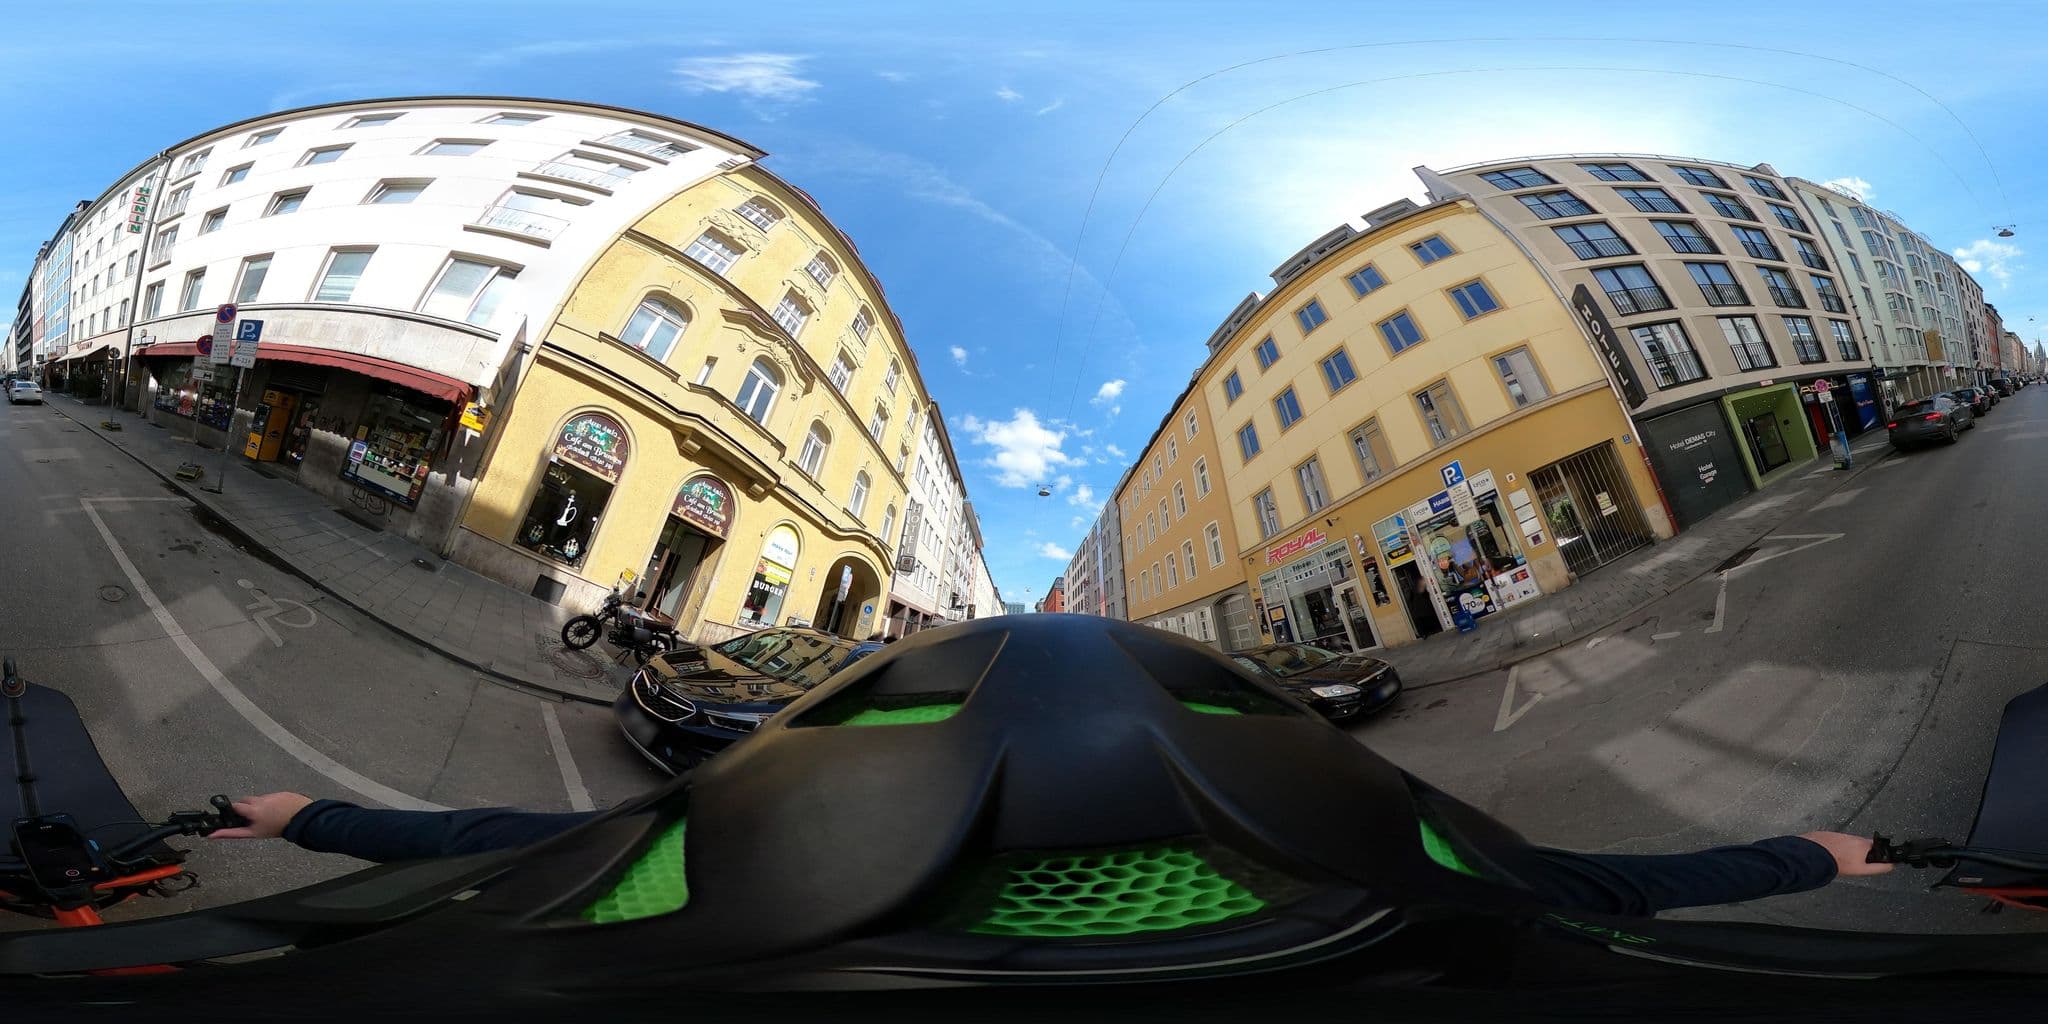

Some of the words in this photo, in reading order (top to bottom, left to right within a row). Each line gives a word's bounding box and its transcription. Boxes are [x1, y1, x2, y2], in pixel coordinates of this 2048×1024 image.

[131, 187, 150, 232] HANIN
[240, 322, 256, 339] P
[1581, 304, 1629, 386] HOTEL
[564, 432, 582, 446] Café
[1669, 441, 1685, 450] Hotel
[1685, 433, 1706, 445] DEMAS
[1443, 466, 1457, 485] P
[1698, 462, 1714, 473] Hotel
[1700, 469, 1718, 480] Garage
[684, 494, 698, 506] Café
[906, 504, 921, 554] HOTEL
[1267, 528, 1328, 565] ROYAL
[753, 580, 784, 597] BURGER
